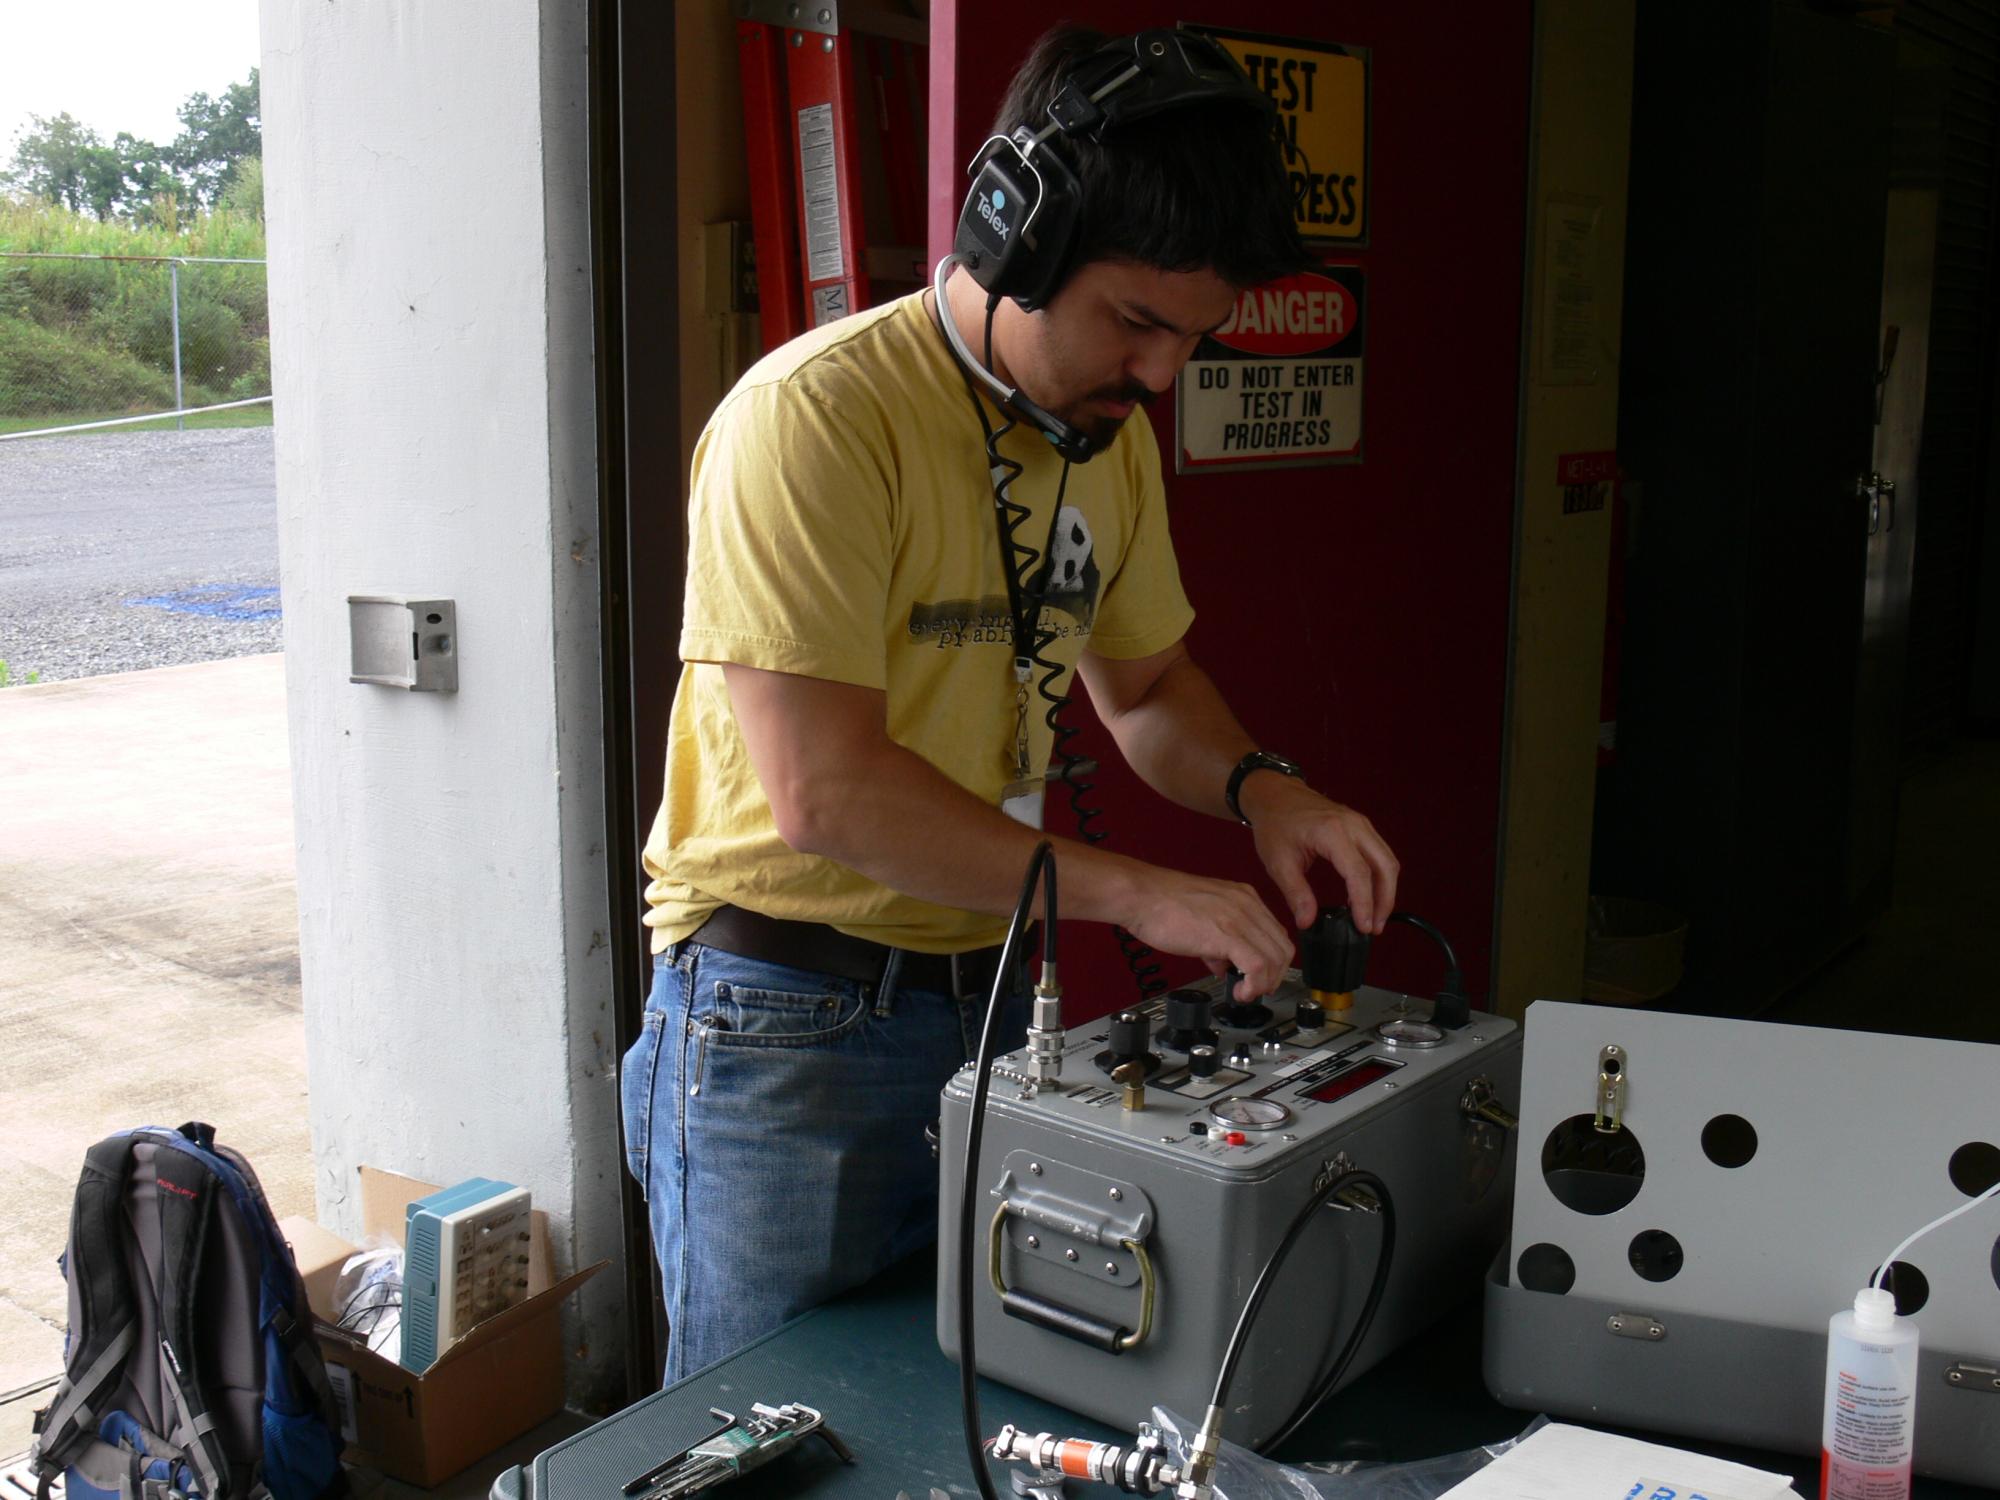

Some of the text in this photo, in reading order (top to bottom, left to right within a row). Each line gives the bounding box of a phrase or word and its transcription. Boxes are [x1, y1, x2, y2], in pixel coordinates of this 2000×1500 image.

[1244, 54, 1317, 112] TEST
[1274, 114, 1297, 166] N
[977, 191, 1010, 241] Telex
[1289, 171, 1357, 226] RESS
[1200, 365, 1354, 390] DO NOT ENTER
[1240, 390, 1323, 420] TEST IN
[1222, 419, 1331, 451] PROGRESS
